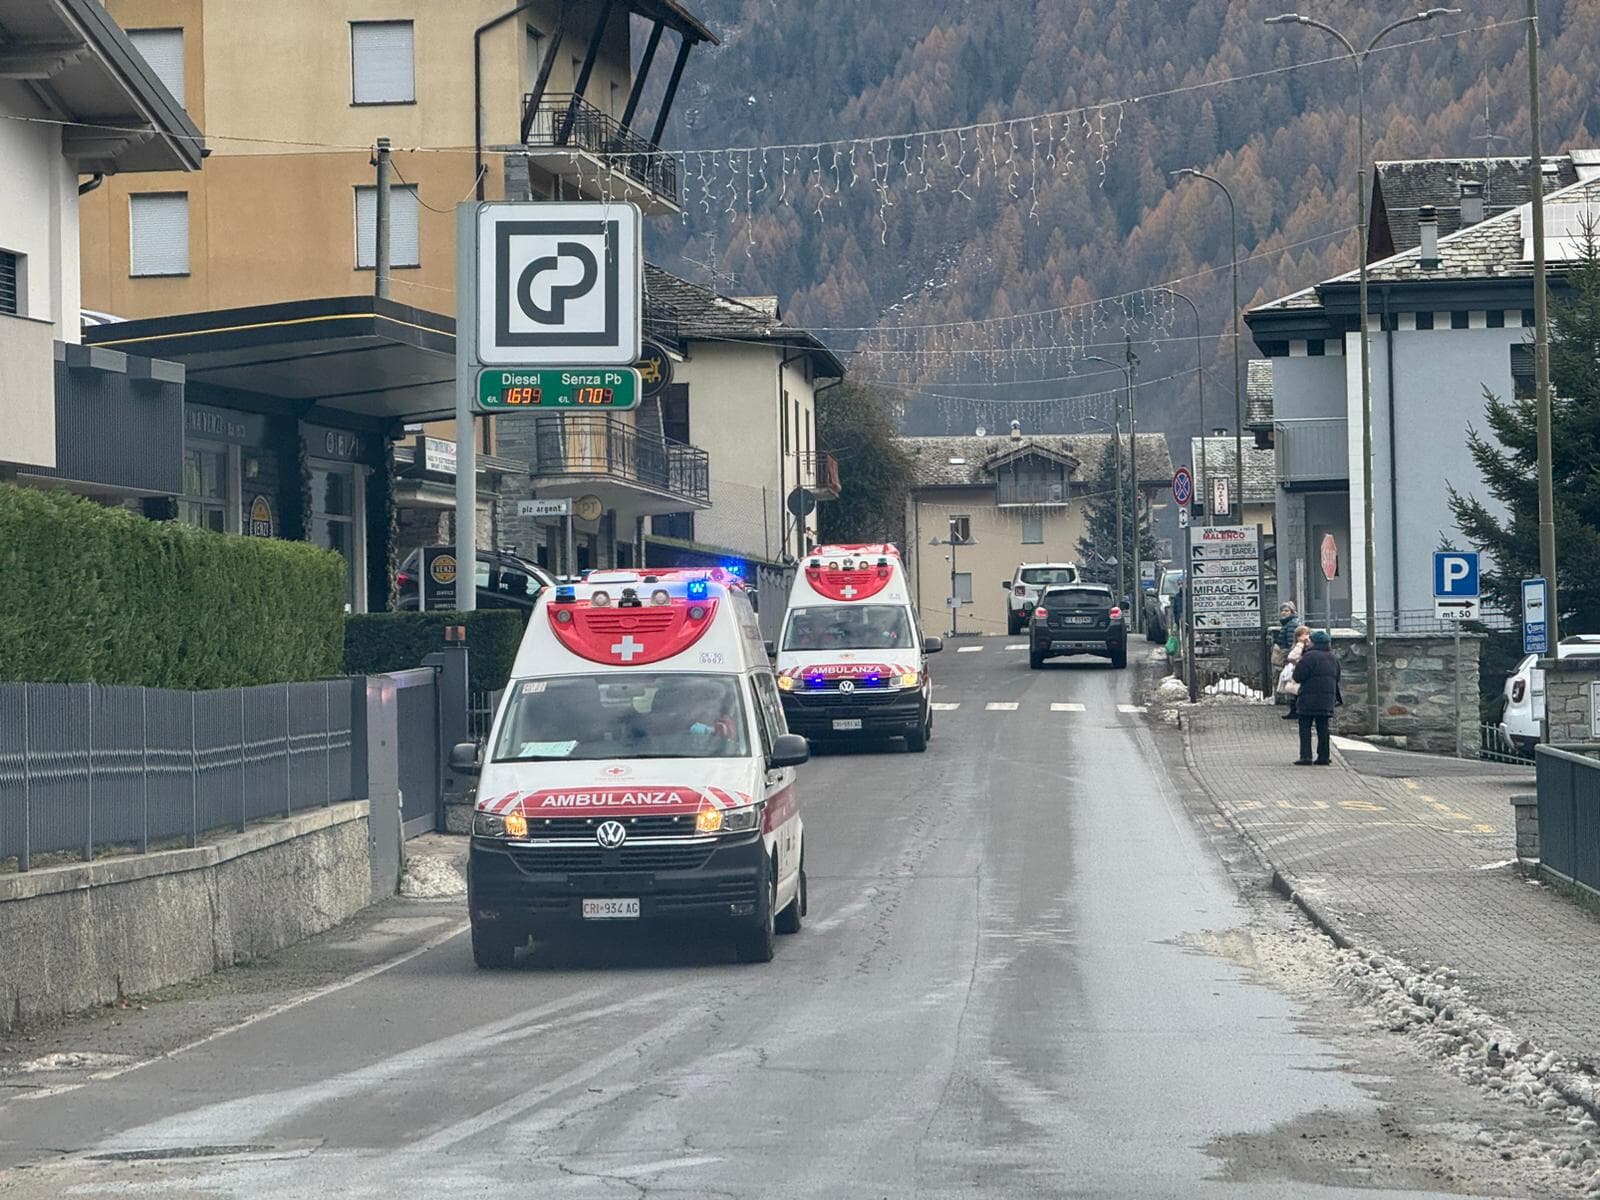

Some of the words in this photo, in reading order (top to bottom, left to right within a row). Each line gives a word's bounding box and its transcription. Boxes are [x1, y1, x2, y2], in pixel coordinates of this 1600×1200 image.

[502, 373, 541, 385] Diesel
[561, 373, 601, 385] Senza
[605, 373, 622, 385] Pb
[1203, 532, 1245, 540] MALENCO
[1444, 558, 1469, 591] P
[1194, 585, 1237, 593] MIRAGE
[1459, 610, 1471, 618] 50
[811, 665, 882, 675] AMBULANZA
[541, 791, 683, 808] AMBULANZA
